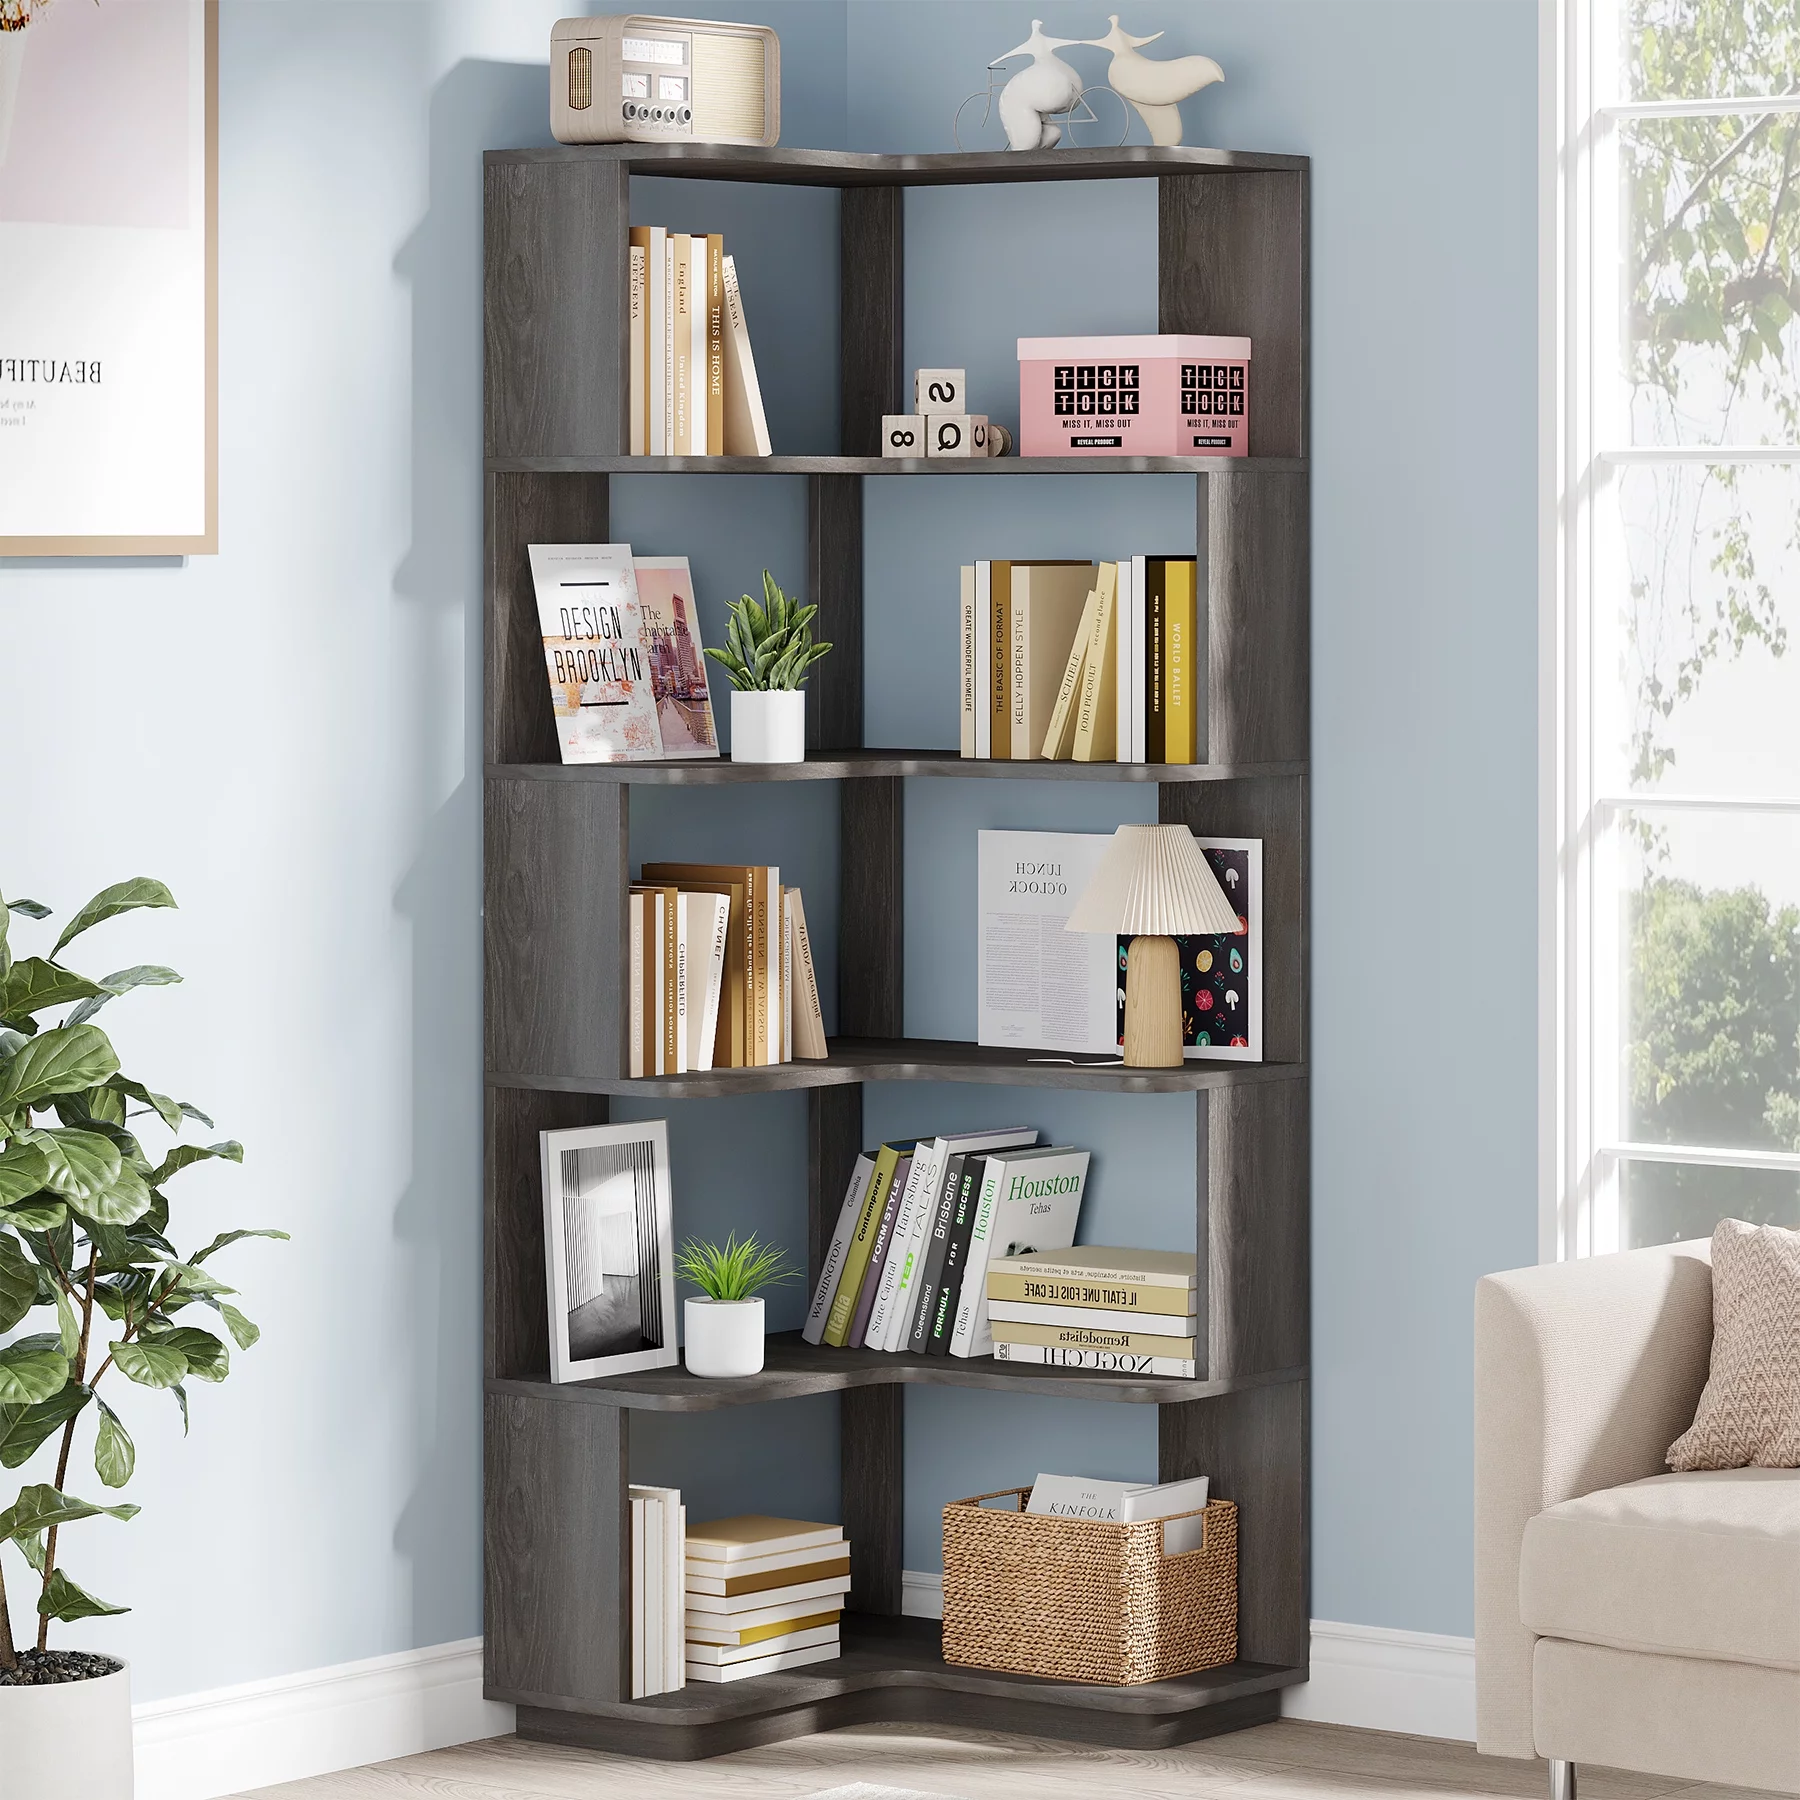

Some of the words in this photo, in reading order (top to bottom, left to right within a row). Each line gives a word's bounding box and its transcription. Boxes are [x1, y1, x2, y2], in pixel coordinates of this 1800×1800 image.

[678, 263, 687, 314] England
[712, 306, 720, 336] THIS
[712, 339, 720, 351] IS
[712, 355, 720, 395] HOME
[1060, 369, 1134, 386] TICK
[1185, 369, 1240, 386] TICK
[678, 392, 686, 436] Kingdom
[1060, 394, 1134, 411] TOCK
[1185, 394, 1240, 411] TOCK
[890, 430, 915, 447] 8
[1062, 420, 1081, 428] MISS
[1084, 420, 1093, 429] IT,
[1096, 420, 1114, 428] MISS
[1117, 419, 1131, 428] OUT
[1187, 419, 1201, 428] MISS
[1212, 420, 1226, 428] MISS
[1228, 420, 1239, 428] OUT
[640, 605, 662, 620] The
[1097, 591, 1106, 617] glance
[560, 606, 623, 641] DESIGN
[996, 602, 1004, 644] FORMAT
[1016, 610, 1024, 642] STYLE
[1094, 618, 1102, 646] second
[965, 634, 973, 675] WONDERFUL
[996, 646, 1004, 660] OF
[1173, 623, 1181, 664] WORLD
[554, 648, 643, 683] BROOKLYN
[996, 662, 1004, 695] BASIC
[1016, 645, 1024, 692] HOPPEN
[1060, 653, 1081, 703] SCHIELE
[1084, 664, 1097, 707] PICOULT
[1173, 668, 1181, 707] BALLET
[996, 698, 1004, 713] THE
[1016, 694, 1024, 725] KELLY
[1081, 710, 1091, 733] JODI
[1008, 1173, 1080, 1202] Houston
[872, 1223, 890, 1264] FORM
[882, 1178, 901, 1221] STYLE
[973, 1179, 996, 1242] Houston
[1030, 1203, 1052, 1215] Tehas
[898, 1252, 914, 1290] TED
[913, 1163, 938, 1240] TALKS
[812, 1239, 842, 1319] WASHINGTON
[847, 1175, 862, 1208] Columbia
[870, 1303, 887, 1335] State
[880, 1260, 898, 1303] Capital
[896, 1159, 926, 1239] Harrisburg
[914, 1284, 932, 1340] Queensland
[934, 1172, 959, 1240] Brisbane
[934, 1287, 951, 1340] FORMULA
[948, 1242, 959, 1266] FOR
[956, 1174, 972, 1225] SUCCESS
[826, 1294, 852, 1335] Italia
[1050, 1503, 1116, 1520] KINFOLK
[1081, 1492, 1097, 1501] THE
